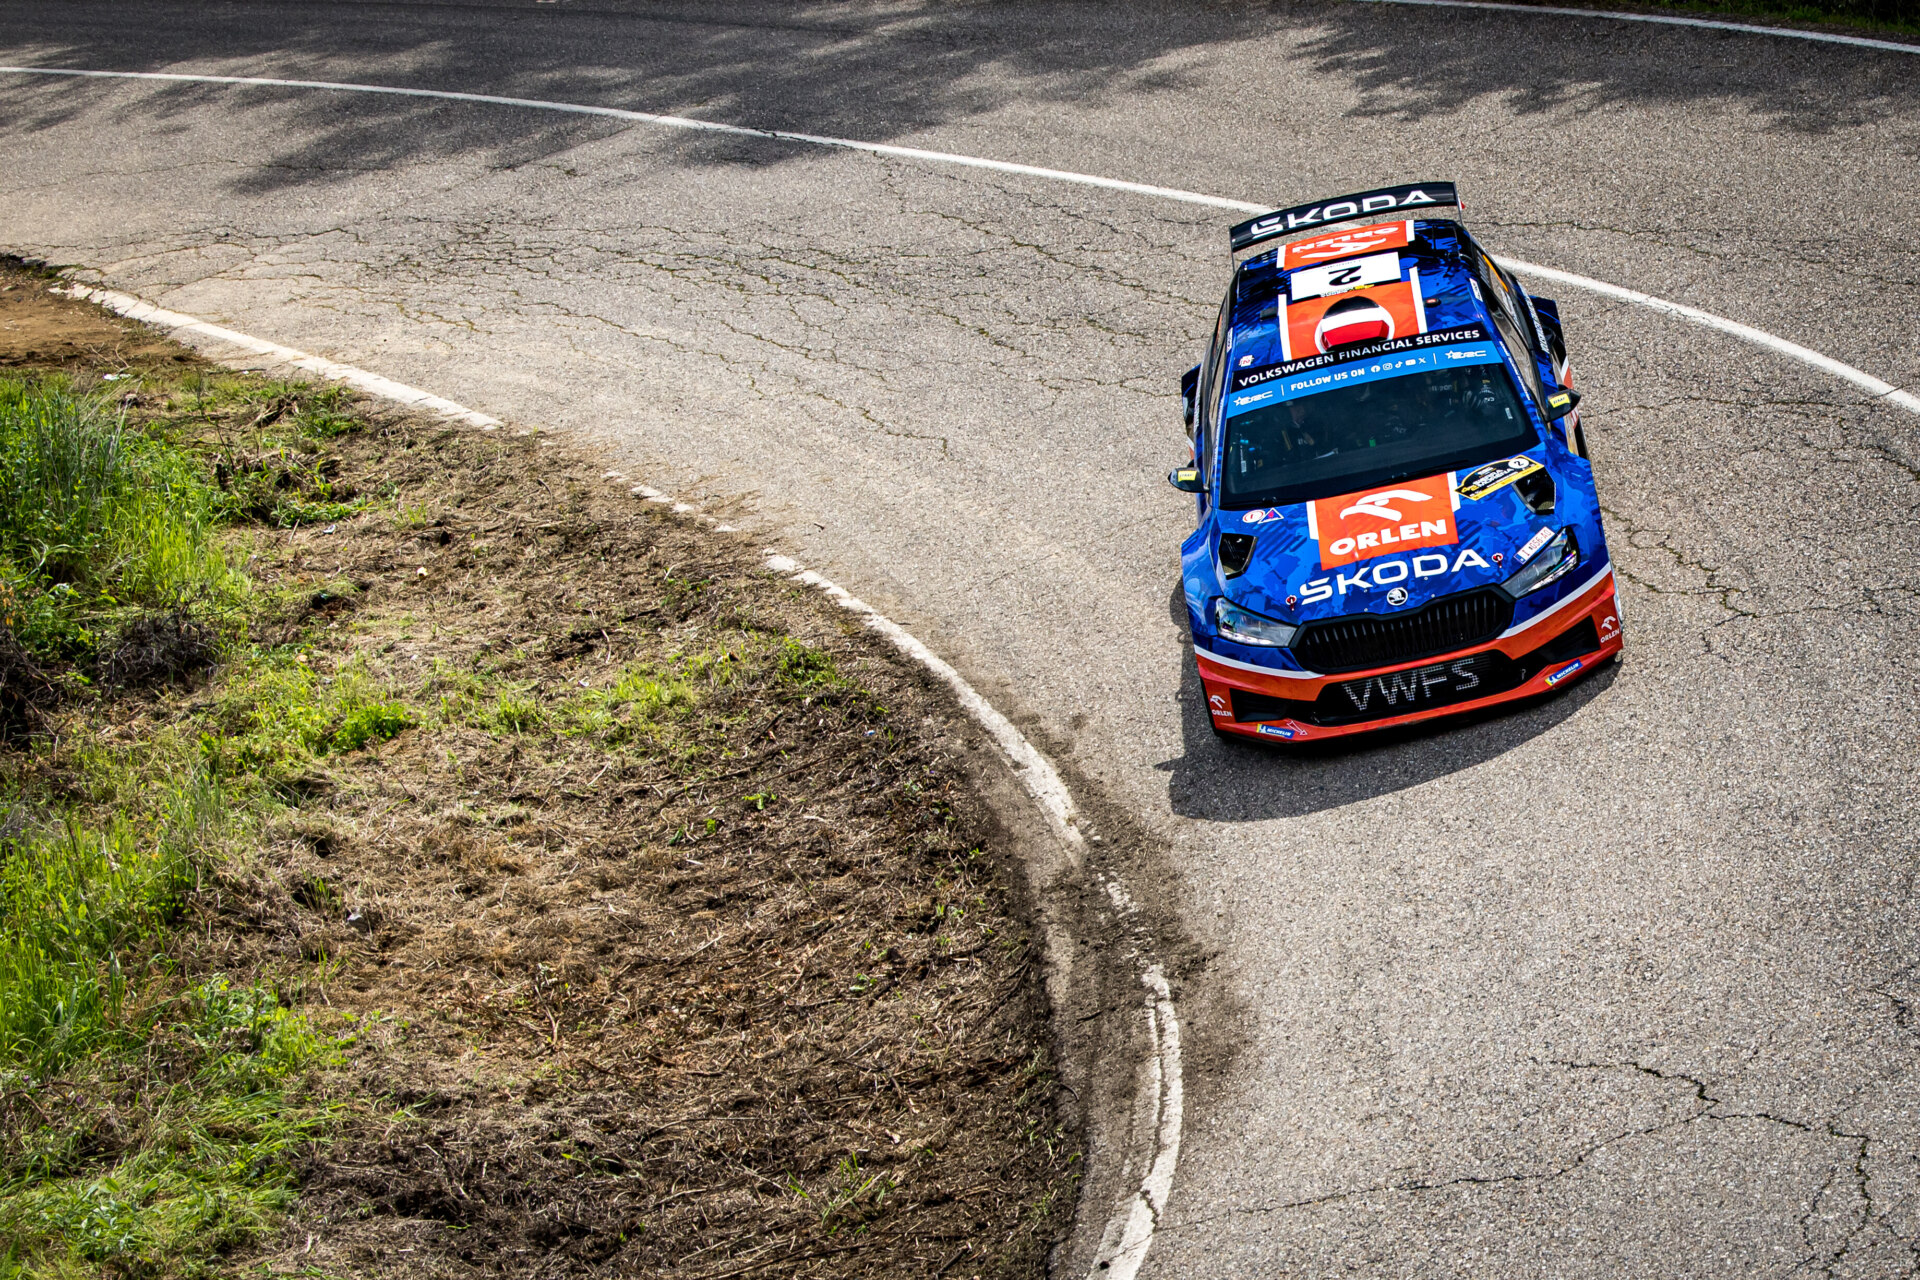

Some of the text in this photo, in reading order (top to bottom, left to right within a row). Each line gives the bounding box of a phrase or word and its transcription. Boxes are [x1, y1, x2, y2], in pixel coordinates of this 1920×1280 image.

[1292, 227, 1399, 253] ORLEN
[1328, 265, 1361, 286] 2
[1239, 354, 1334, 387] VOLKSWAGEN
[1339, 339, 1413, 360] FINANCIAL
[1416, 330, 1480, 345] SERVICES
[1290, 375, 1331, 391] FOLLOW
[1334, 372, 1348, 381] US
[1351, 368, 1365, 377] ON
[1329, 519, 1447, 556] ORLEN
[1600, 628, 1620, 643] ORLEN
[1556, 662, 1579, 678] MICHELIN
[1341, 658, 1480, 711] VWFS
[1211, 709, 1233, 717] ORLEN
[1266, 727, 1292, 736] MICHELIN
